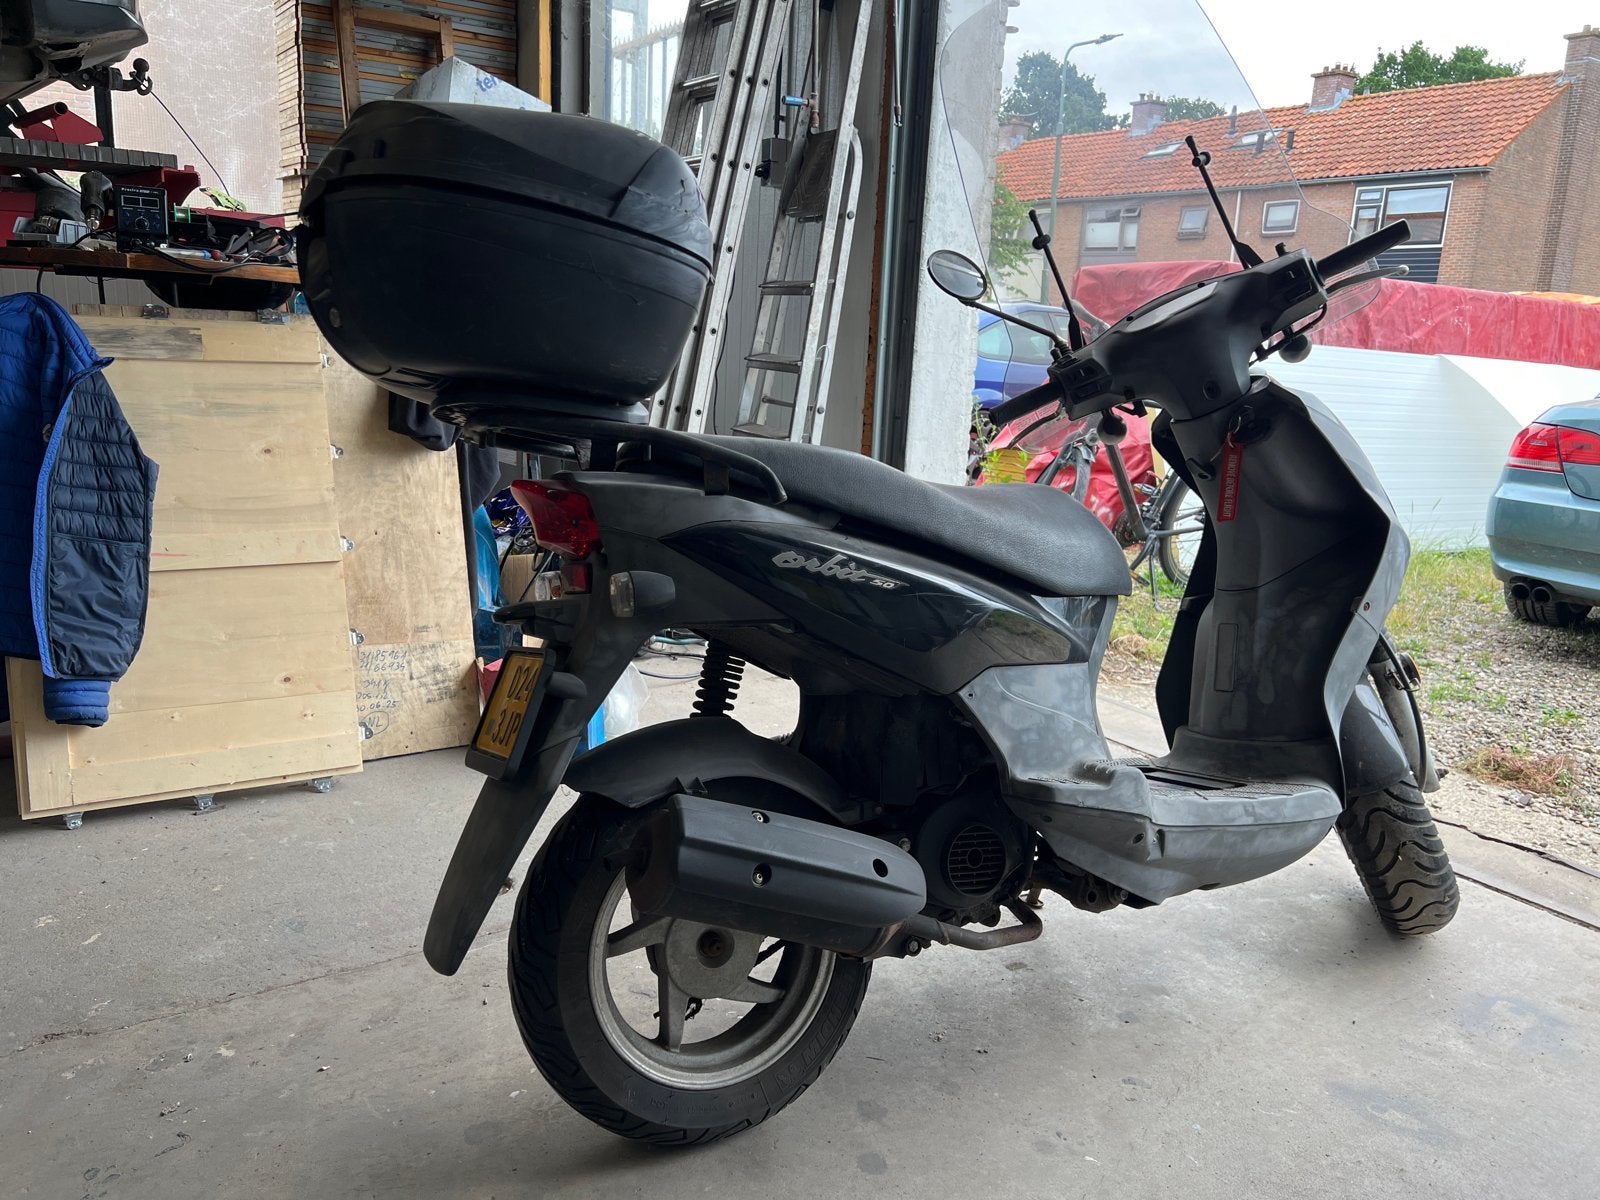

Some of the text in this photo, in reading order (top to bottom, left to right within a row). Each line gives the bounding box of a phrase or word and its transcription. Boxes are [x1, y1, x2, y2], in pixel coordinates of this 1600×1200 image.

[1223, 454, 1238, 517] REMOVE BEFORE FLIGHT
[869, 579, 895, 588] 50
[507, 665, 539, 702] D24
[491, 708, 522, 747] 3JP
